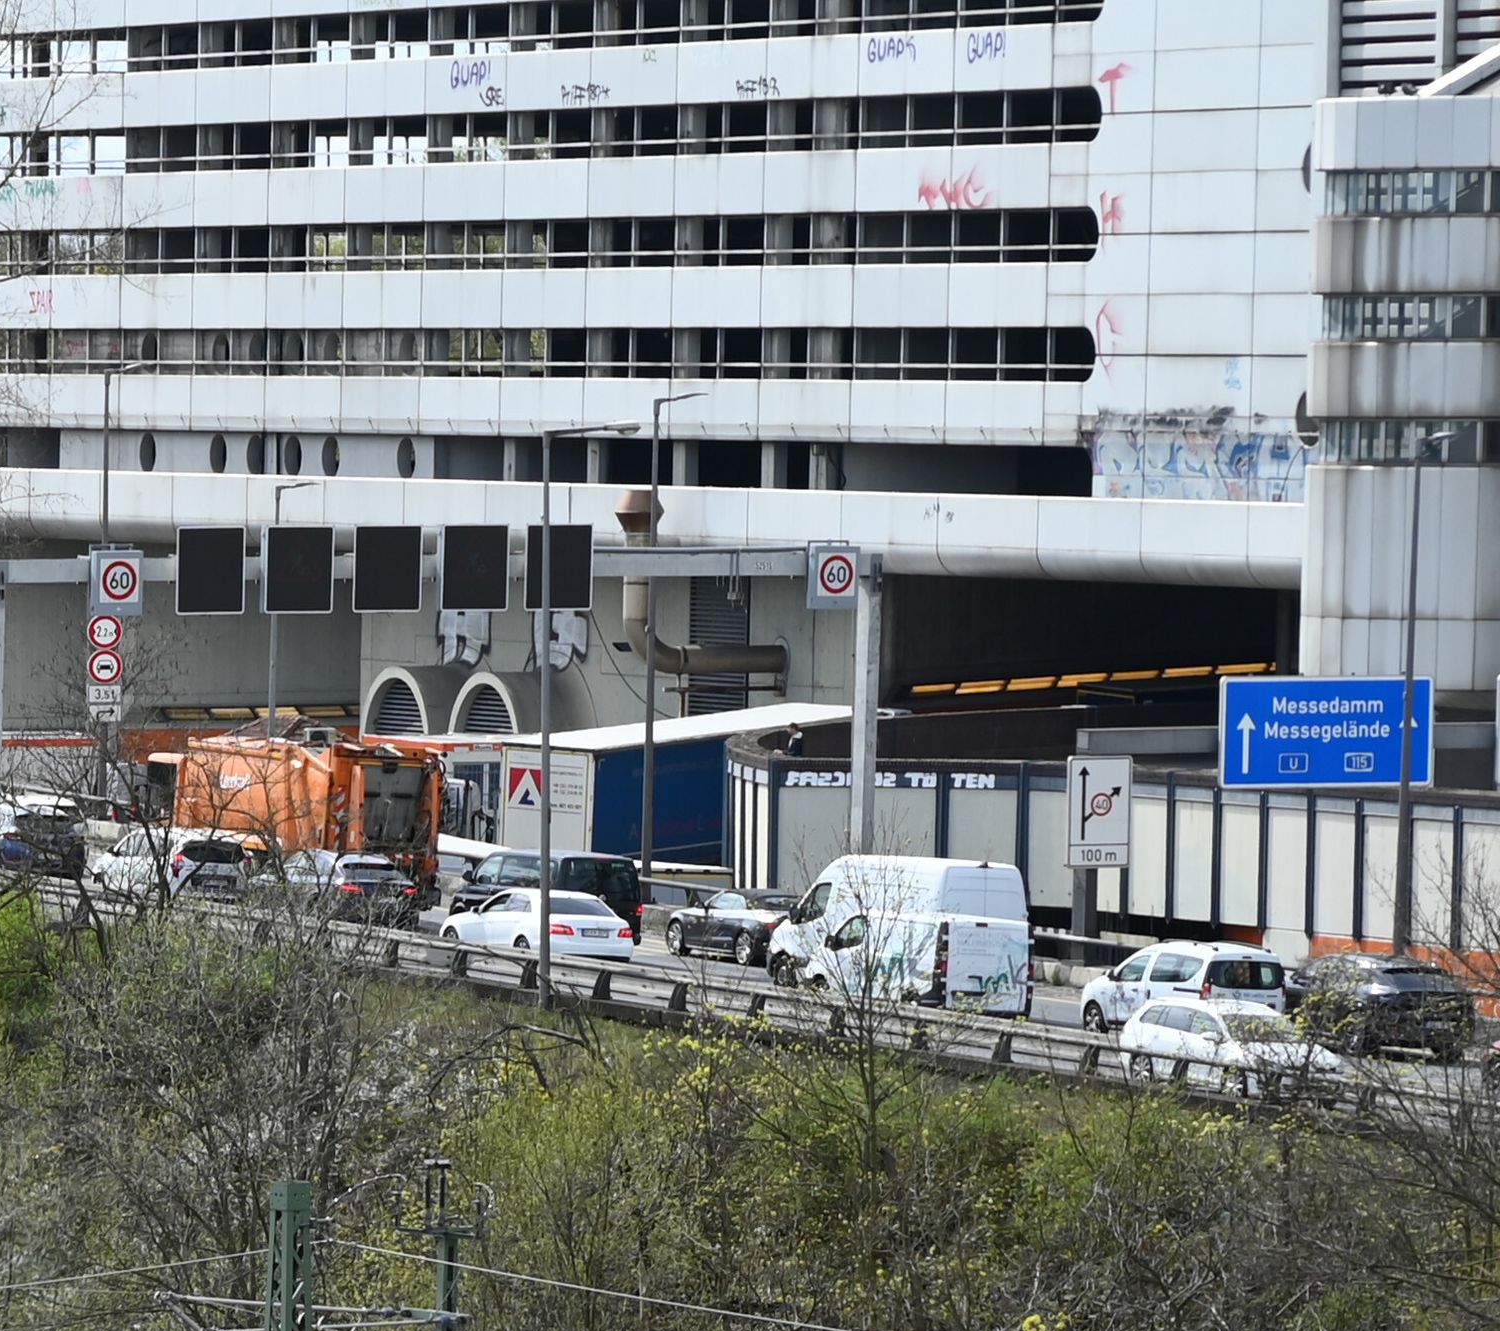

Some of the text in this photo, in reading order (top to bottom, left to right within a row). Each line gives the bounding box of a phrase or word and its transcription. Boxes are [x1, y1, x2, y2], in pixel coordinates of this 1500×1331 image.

[109, 572, 130, 590] 60
[826, 566, 847, 583] 60
[1272, 696, 1384, 715] Messedamm
[1264, 720, 1391, 743] Messegelände
[1351, 756, 1368, 769] 115
[1081, 849, 1117, 862] 100 m
